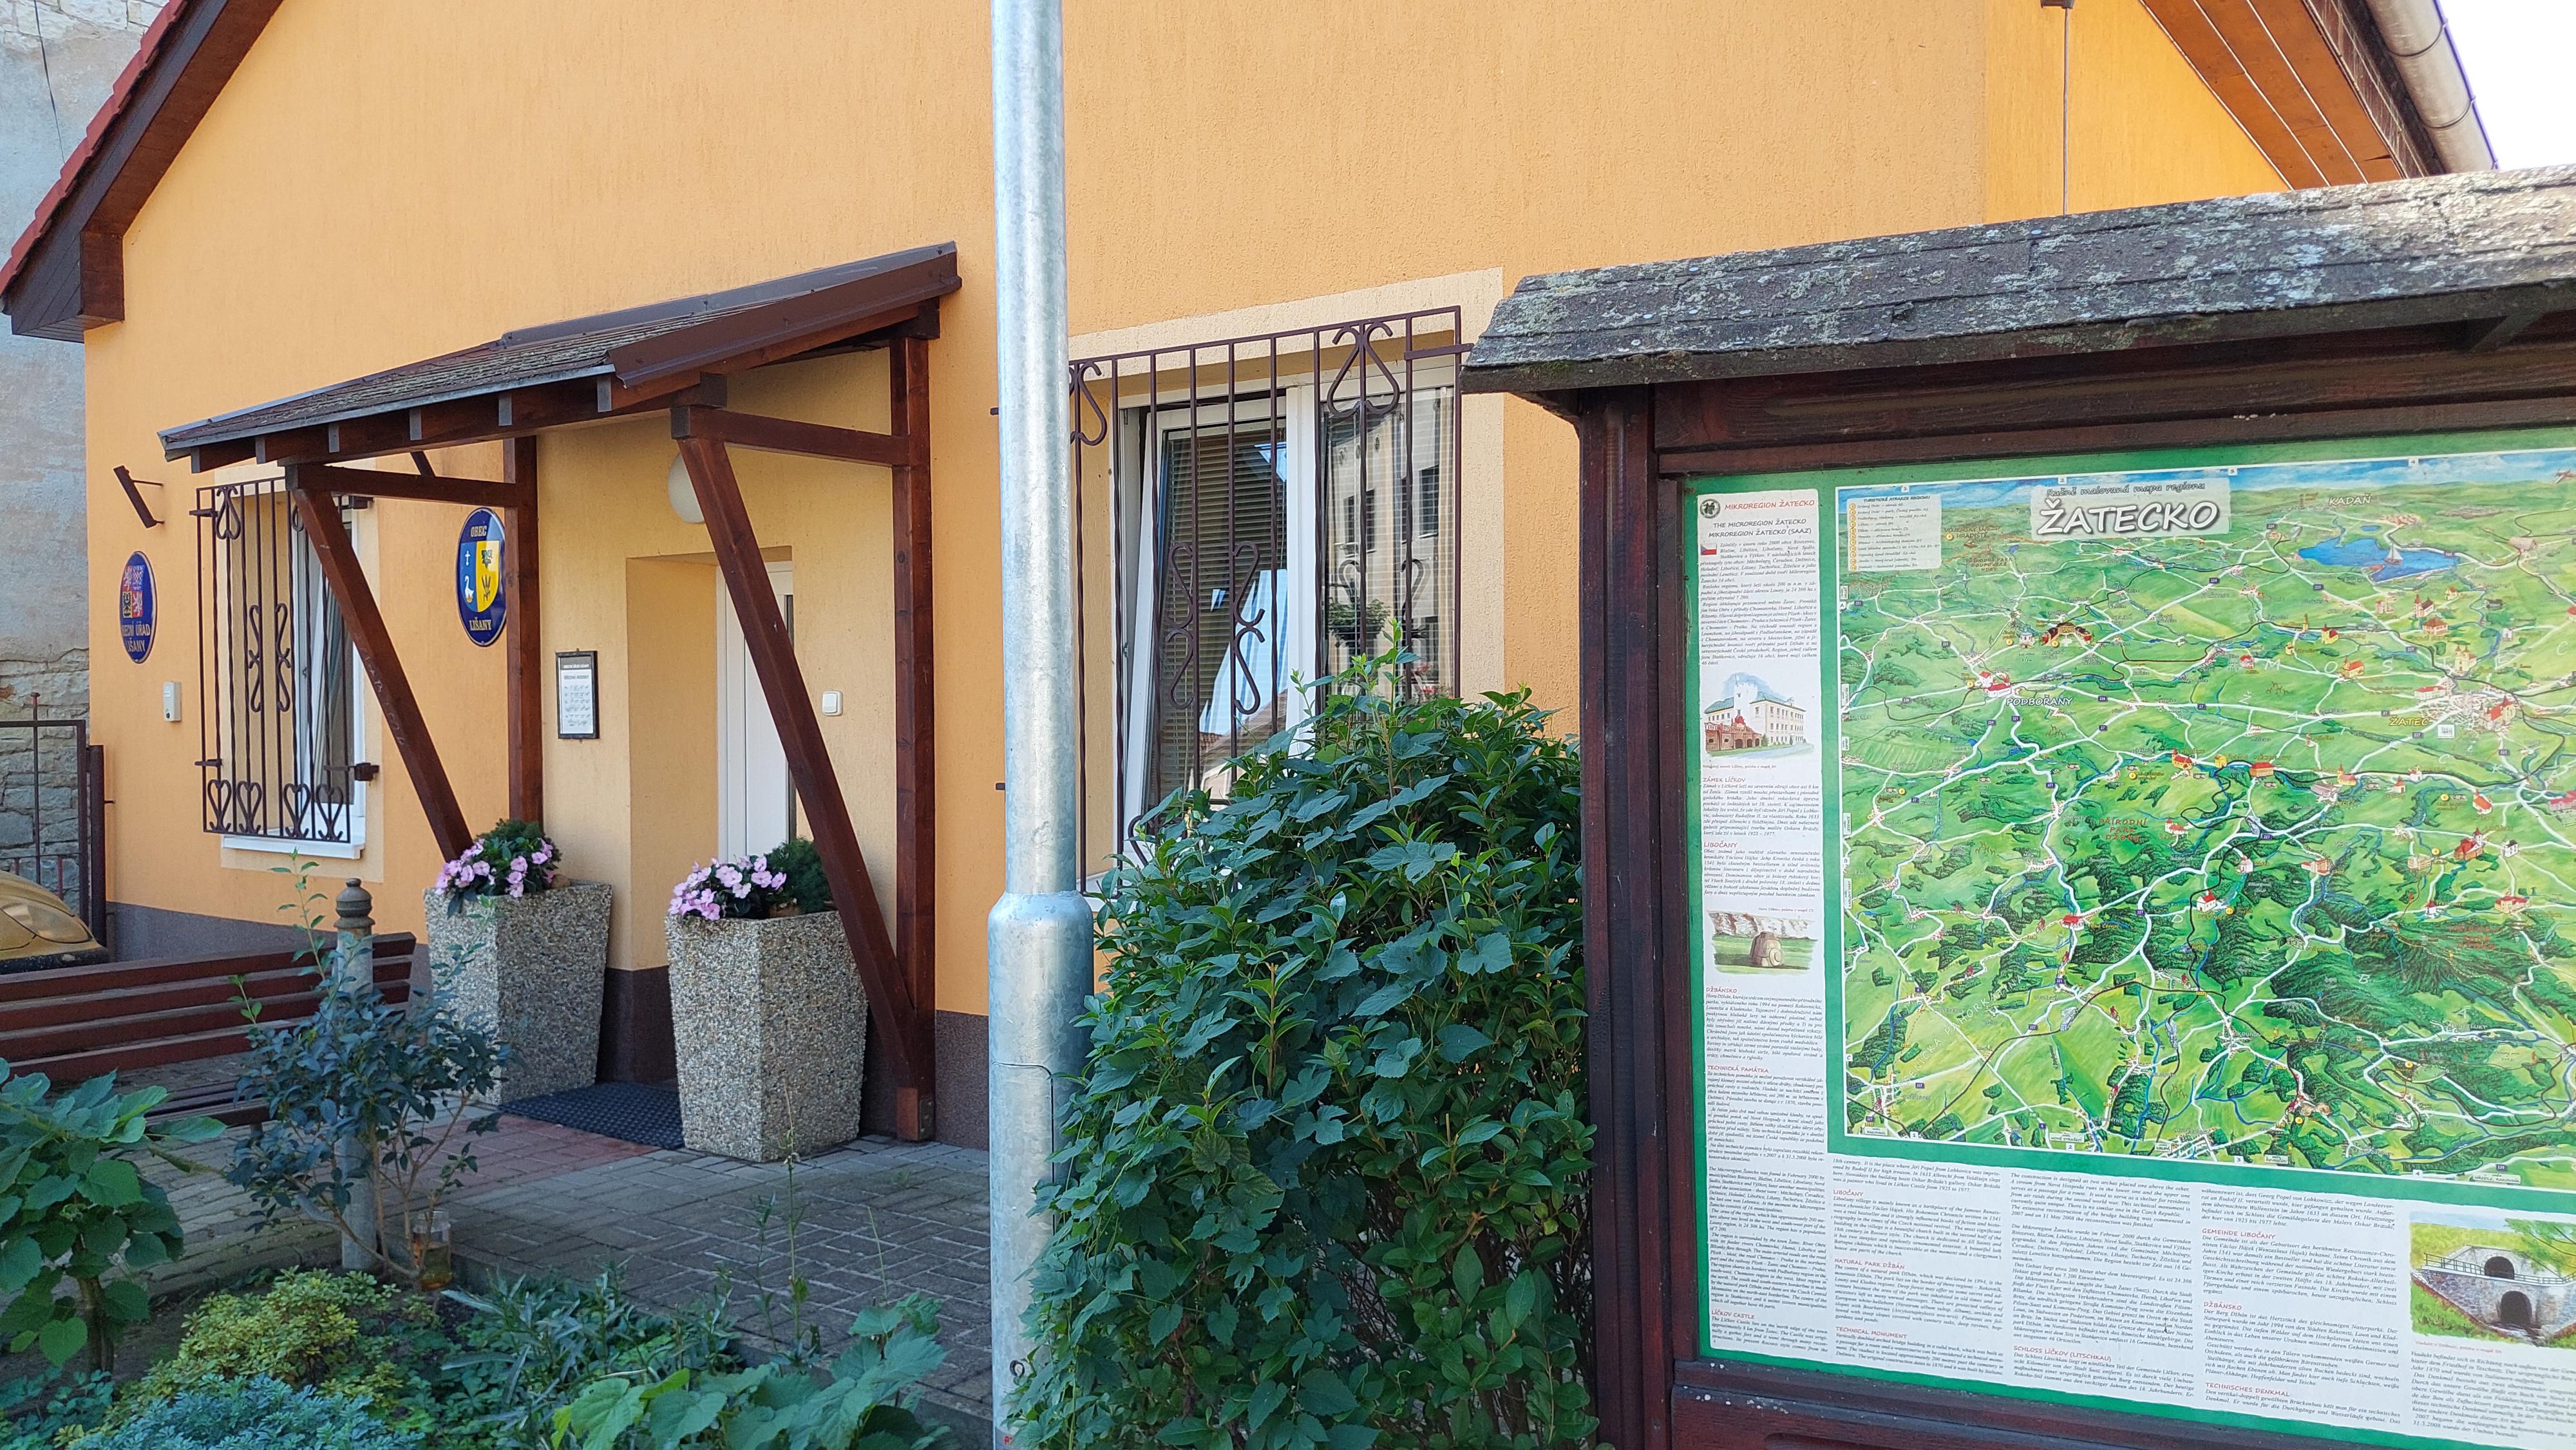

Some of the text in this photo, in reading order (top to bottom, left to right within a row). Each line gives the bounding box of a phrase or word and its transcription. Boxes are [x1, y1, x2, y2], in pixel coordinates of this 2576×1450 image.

[2080, 482, 2130, 495] malovaná
[2134, 484, 2164, 494] mapa
[2166, 481, 2206, 493] regionu
[1779, 499, 1815, 507] ŽATECKO
[2328, 493, 2372, 506] KADAŇ
[2037, 498, 2221, 534] ŽATECKO
[470, 525, 488, 538] OBEC
[469, 616, 492, 631] LIŠANY
[2006, 694, 2073, 706] PODBOŘANY
[2389, 715, 2430, 727] ŽATEC
[1833, 1188, 1862, 1196] LIBOČANY
[2240, 1230, 2275, 1239] LIBOČANY
[2204, 1301, 2242, 1310] DŽBÁNSKO
[2044, 1347, 2067, 1356] LÍČKOV
[2070, 1351, 2111, 1361] (LITSCHKAU)
[2205, 1382, 2289, 1397] TECHNISCHES DENKMAL
